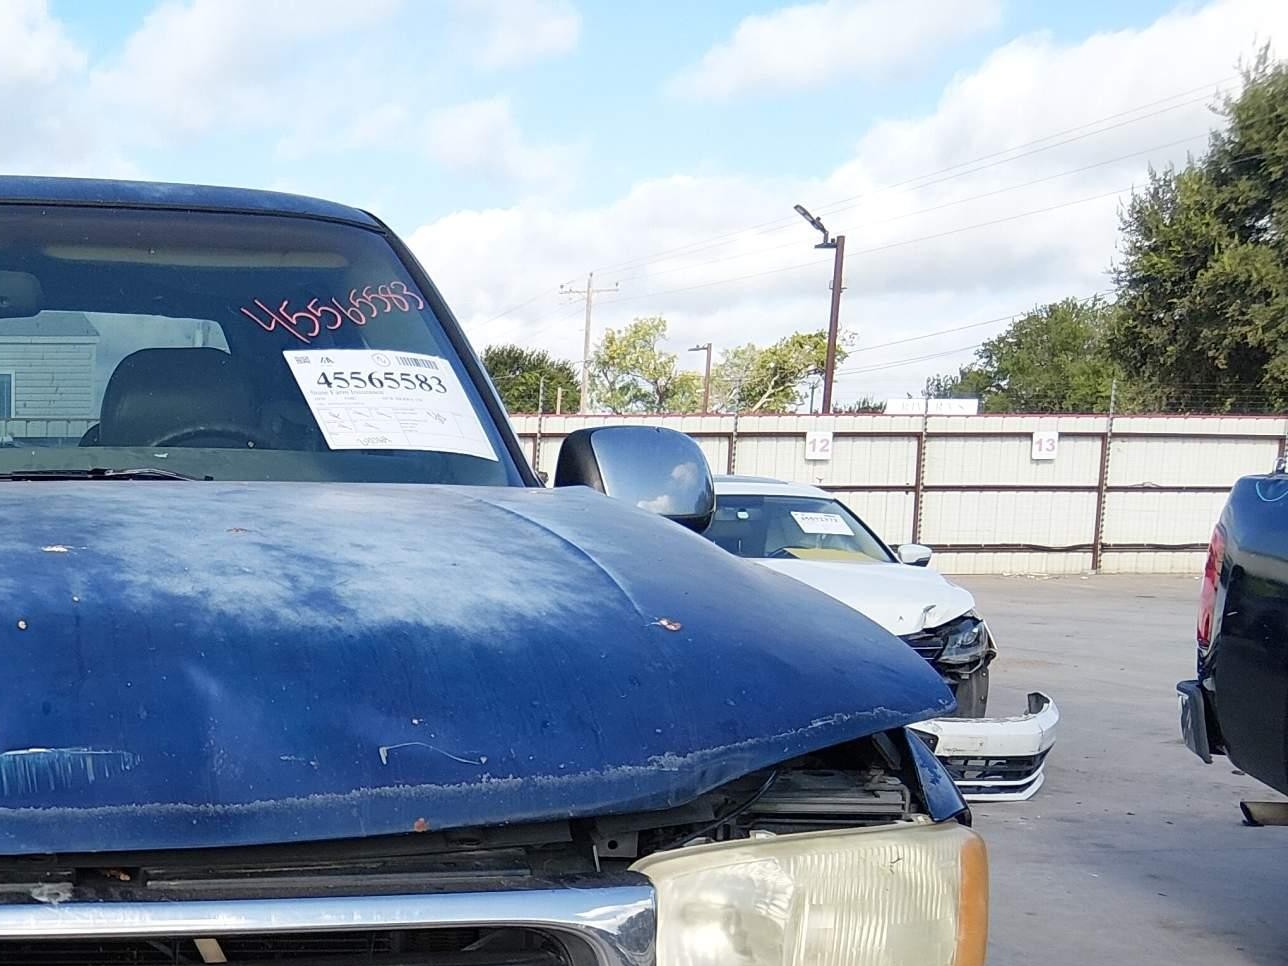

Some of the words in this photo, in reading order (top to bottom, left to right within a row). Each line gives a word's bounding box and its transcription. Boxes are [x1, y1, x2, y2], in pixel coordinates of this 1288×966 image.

[241, 281, 424, 344] 45565583
[316, 371, 448, 394] 45565583
[808, 437, 830, 453] 12
[1034, 437, 1056, 453] 13
